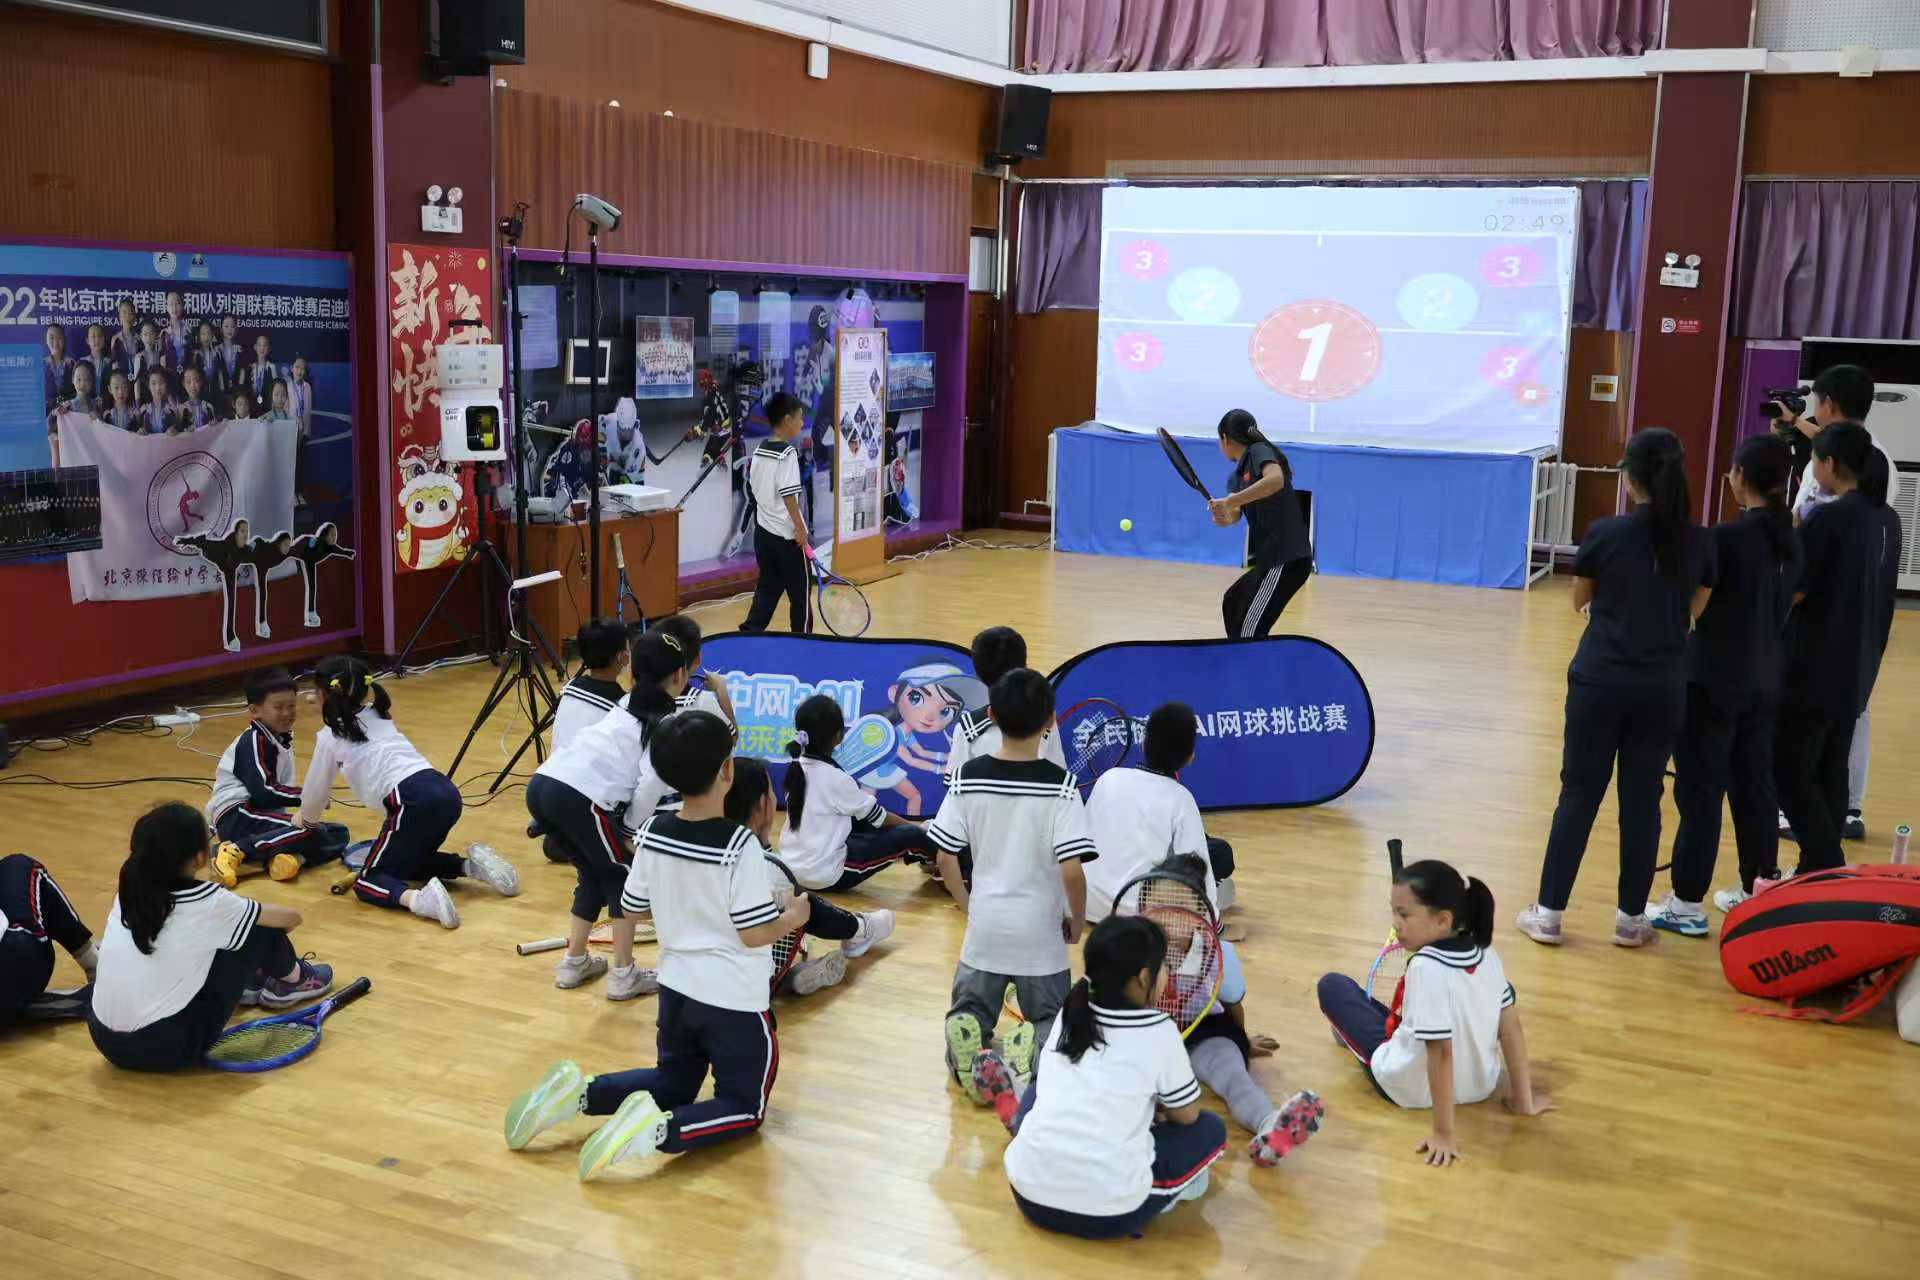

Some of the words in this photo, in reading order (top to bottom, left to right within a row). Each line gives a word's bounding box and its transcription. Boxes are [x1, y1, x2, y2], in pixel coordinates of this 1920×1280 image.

[1134, 250, 1154, 270] 3
[1500, 256, 1521, 278] 3
[236, 319, 260, 328] EAGUE
[1130, 341, 1149, 362] 3
[1296, 322, 1333, 381] 1
[1496, 356, 1519, 379] 3
[1073, 703, 1348, 747] 全民健AI网球挑战赛
[1748, 943, 1839, 985] Wilson
